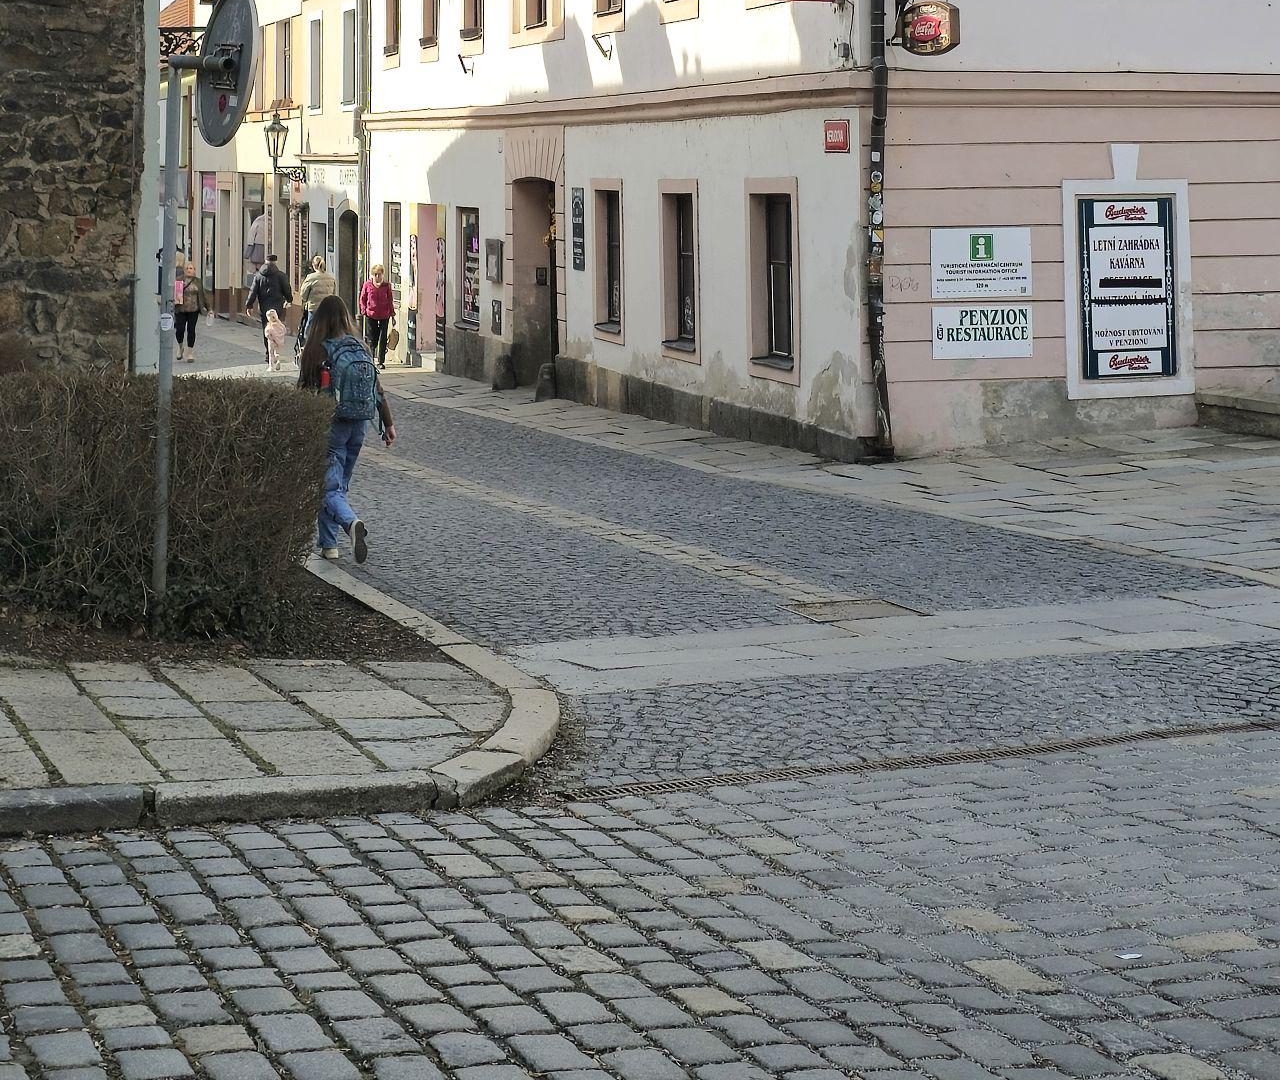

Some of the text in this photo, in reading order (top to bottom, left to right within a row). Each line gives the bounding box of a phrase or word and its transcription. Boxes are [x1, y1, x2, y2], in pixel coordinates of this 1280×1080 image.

[1105, 204, 1148, 219] Budweiser
[1093, 235, 1160, 251] LETNÍ ZAHRÁDKA
[1109, 254, 1145, 269] KAVÁRNA
[959, 308, 1028, 326] PENZION
[946, 326, 1029, 342] RESTAURACE
[1094, 328, 1126, 338] MOŽNOST
[1109, 338, 1149, 347] V PENZIONU
[1108, 354, 1151, 369] Budweiser
